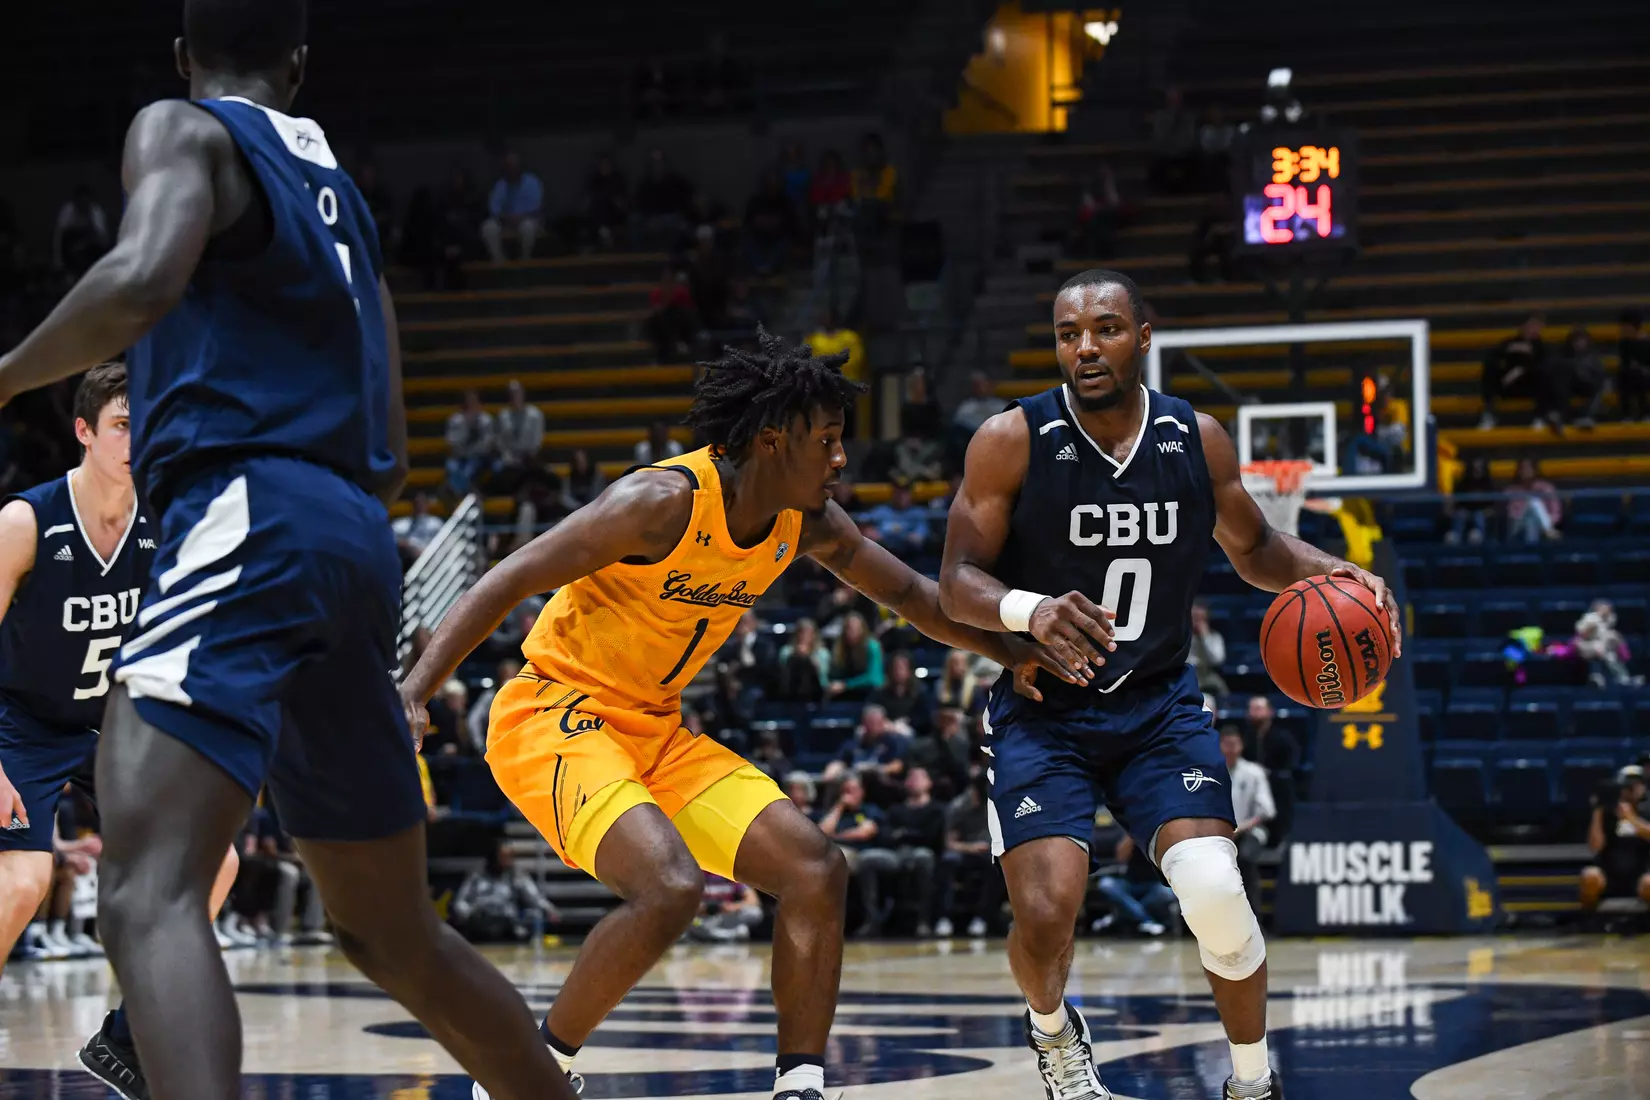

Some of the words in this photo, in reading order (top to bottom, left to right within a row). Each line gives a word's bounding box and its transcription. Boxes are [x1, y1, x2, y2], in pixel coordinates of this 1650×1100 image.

[1272, 145, 1340, 184] 3:34
[1260, 183, 1332, 244] 24
[1157, 440, 1184, 454] WAC
[138, 538, 158, 549] WA
[1069, 501, 1179, 546] CBU
[62, 588, 141, 632] CBU
[1102, 558, 1152, 642] 0
[73, 635, 122, 700] 5
[660, 618, 710, 685] 1
[1316, 627, 1345, 706] Wilson
[1014, 804, 1042, 819] adidas
[1290, 841, 1434, 884] MUSCLE
[1316, 883, 1408, 926] MILK
